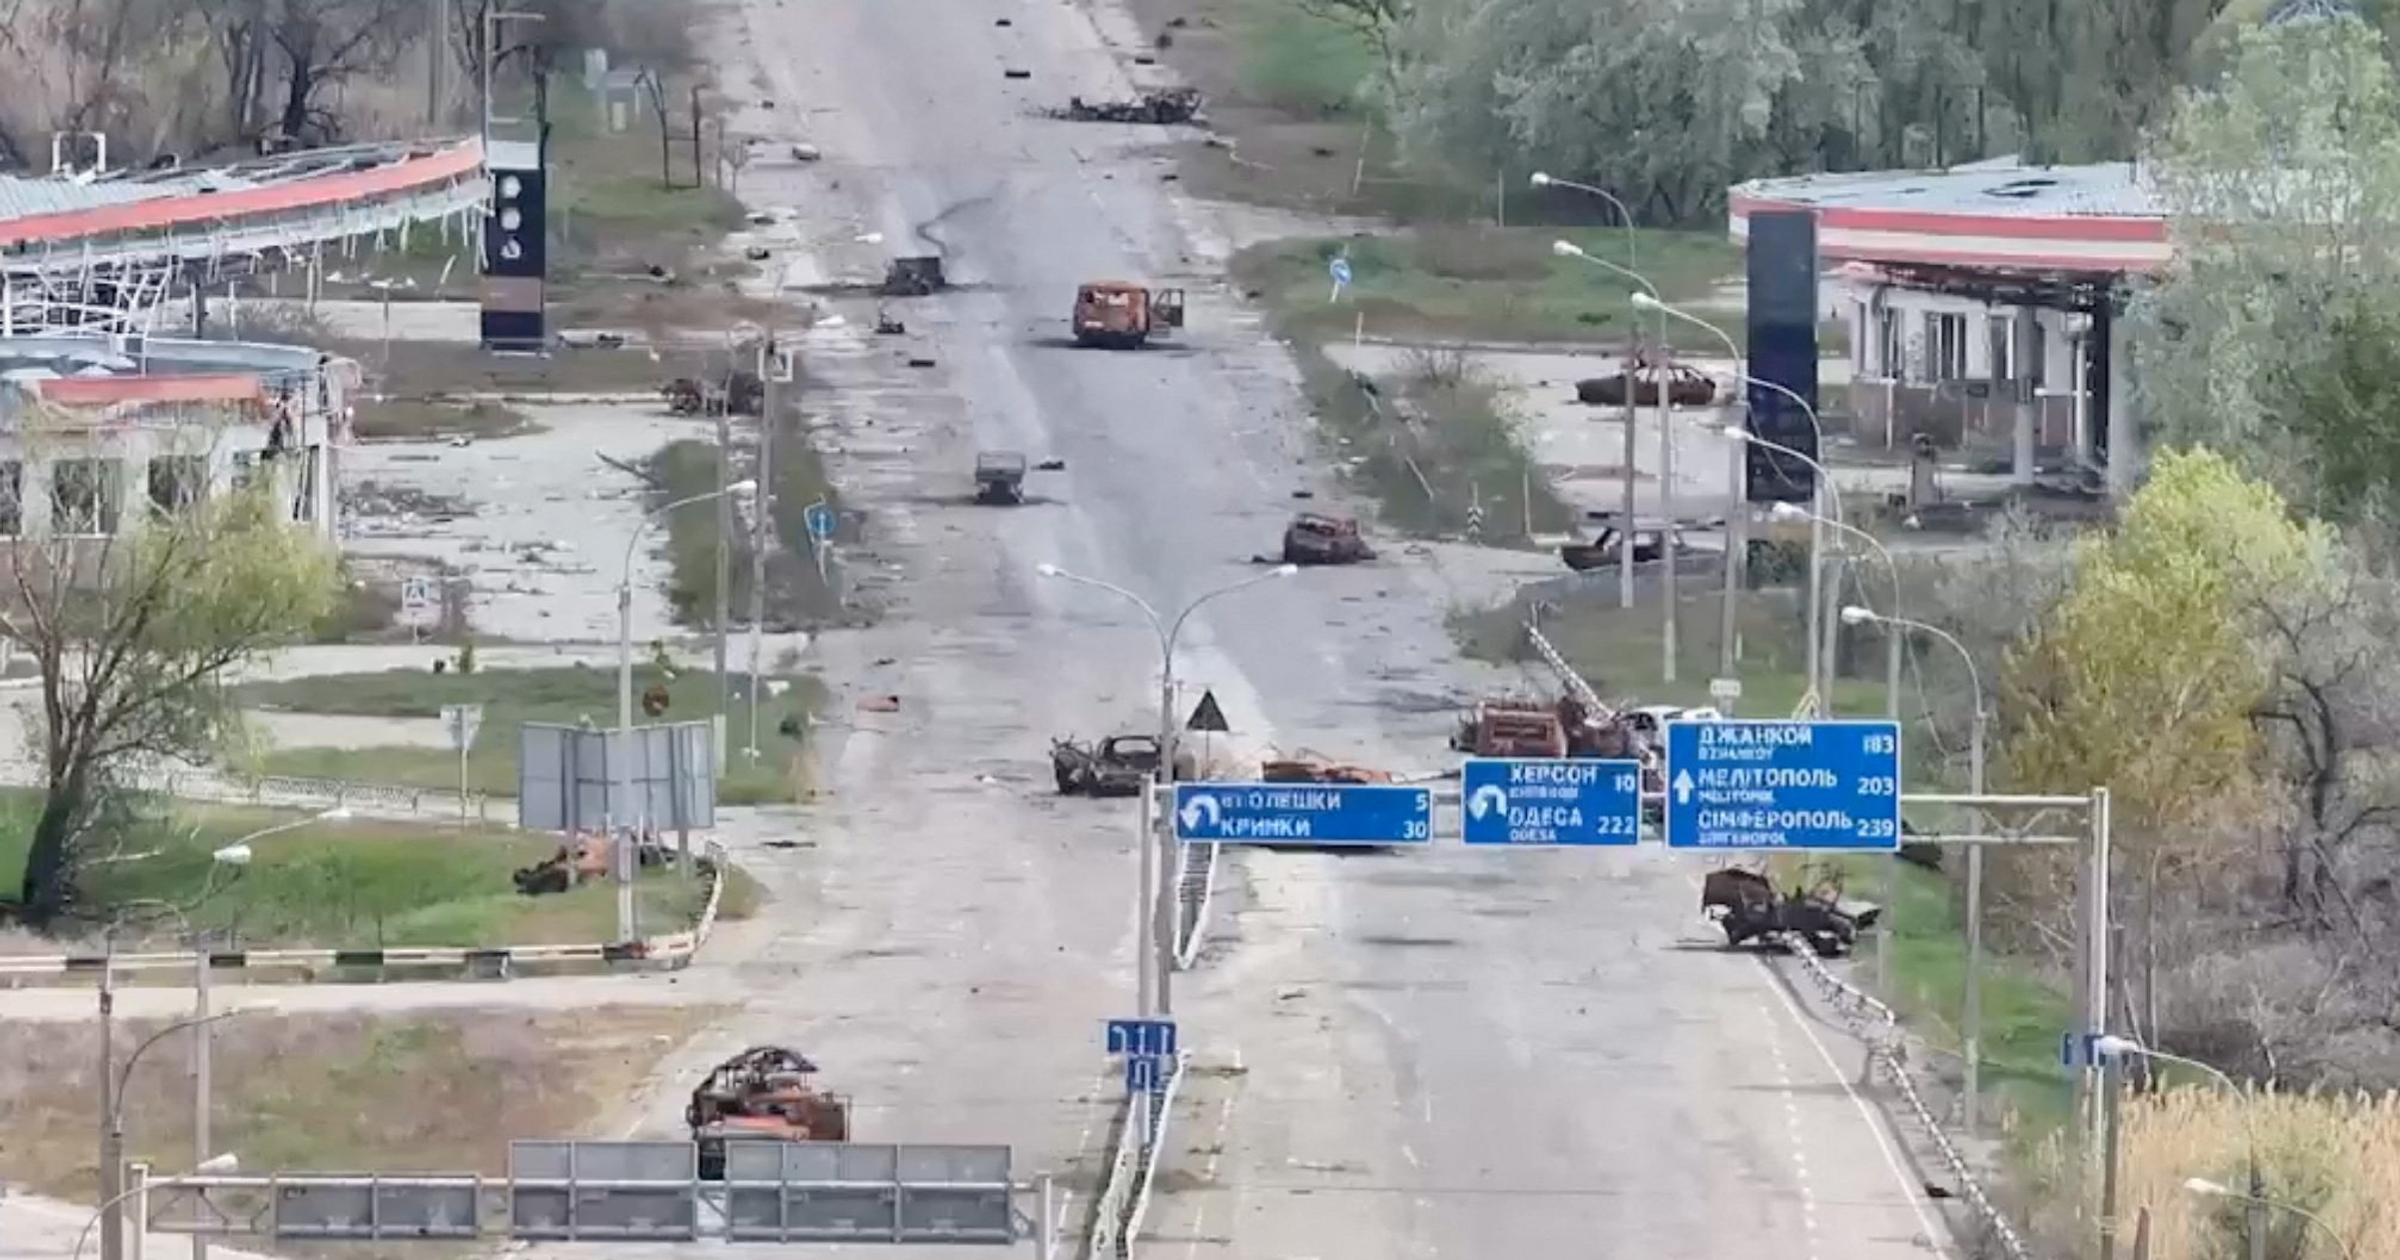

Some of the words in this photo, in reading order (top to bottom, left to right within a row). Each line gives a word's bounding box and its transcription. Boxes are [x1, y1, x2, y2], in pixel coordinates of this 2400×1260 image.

[1699, 726, 1813, 746] ДЖАНКОЙ
[1862, 735, 1894, 755] 183
[1510, 764, 1598, 784] ХЕРСОН
[1615, 774, 1636, 793] 10
[1699, 768, 1838, 788] МЕЛІТОПОЛЬ
[1857, 776, 1895, 796] 203
[1248, 790, 1342, 810] ОЛЕШКИ
[1415, 793, 1427, 811] 5
[1220, 816, 1311, 837] КРИНКИ
[1403, 820, 1427, 839] 30
[1508, 806, 1584, 828] ОДЕСА
[1597, 816, 1636, 835] 222
[1698, 810, 1853, 830] СІМФЕРОПОЛЬ
[1857, 818, 1894, 837] 239
